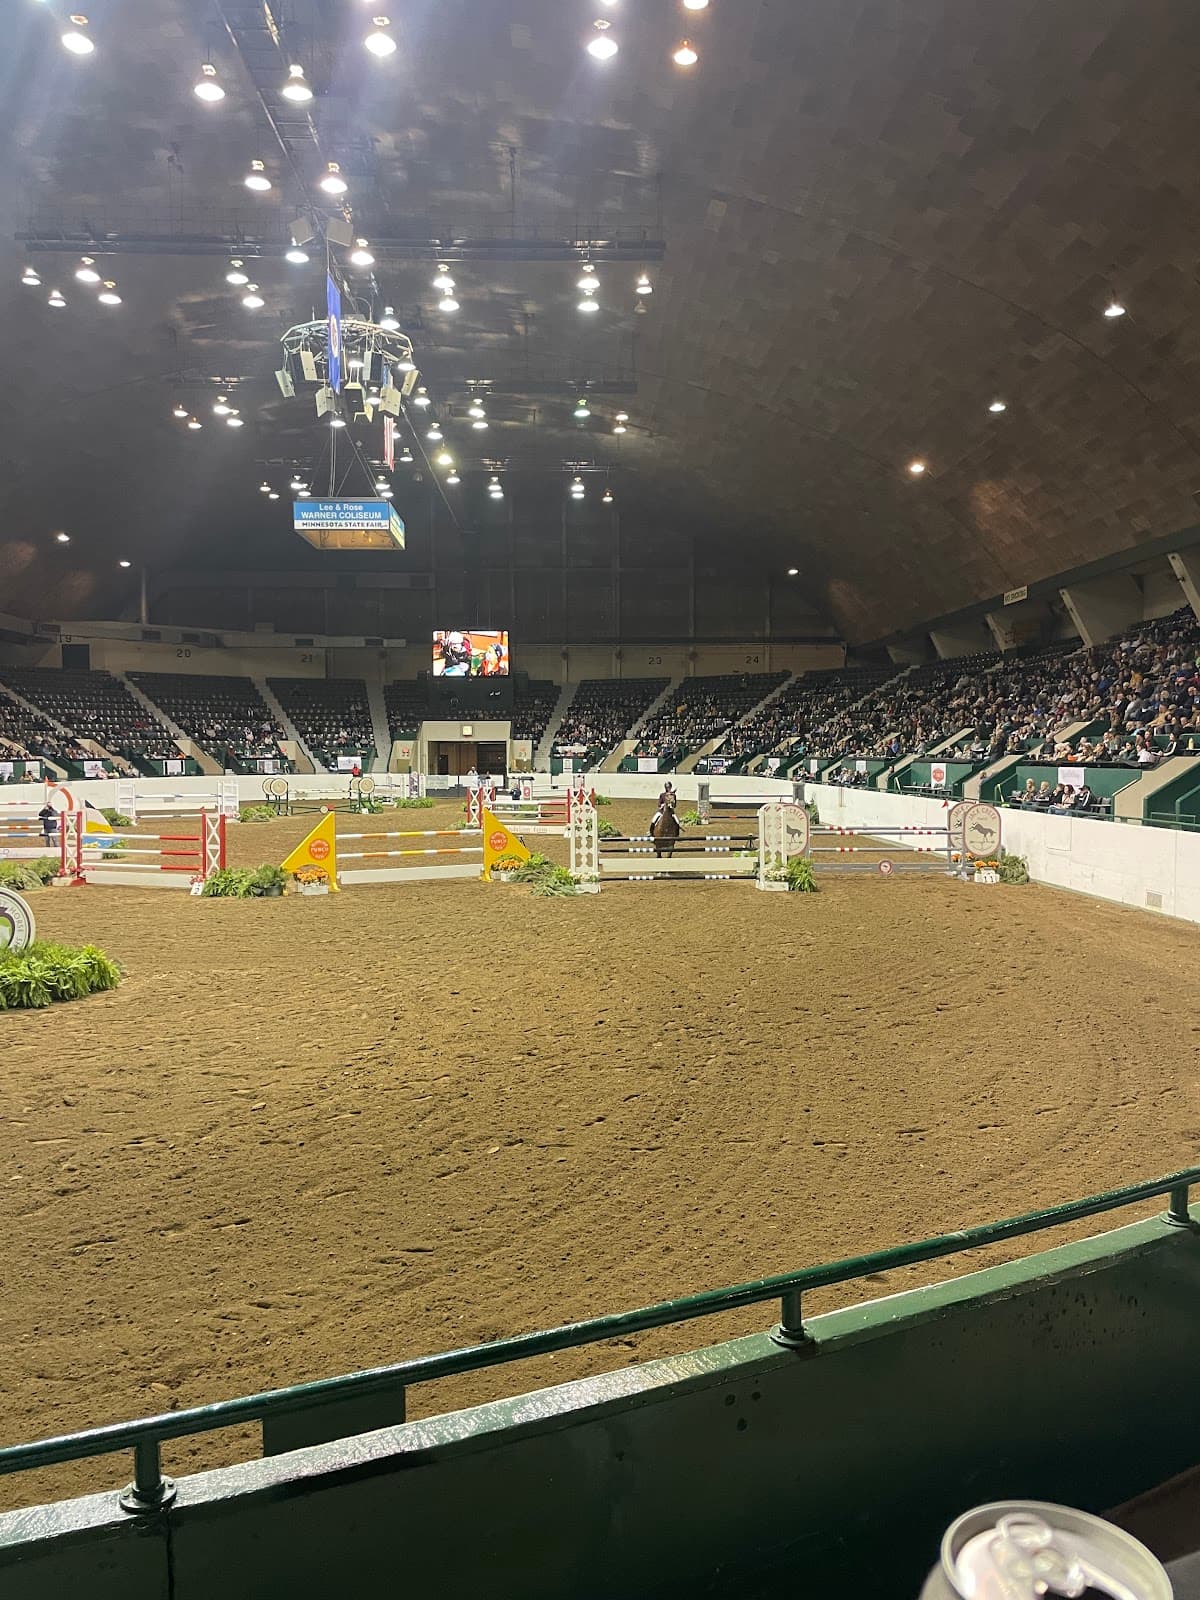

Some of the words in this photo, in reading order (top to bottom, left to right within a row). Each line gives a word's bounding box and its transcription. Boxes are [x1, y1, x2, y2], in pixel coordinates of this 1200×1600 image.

[59, 634, 72, 643] 19
[176, 648, 191, 658] 20
[301, 654, 312, 663] 21
[648, 656, 662, 665] 23
[745, 656, 759, 664] 24
